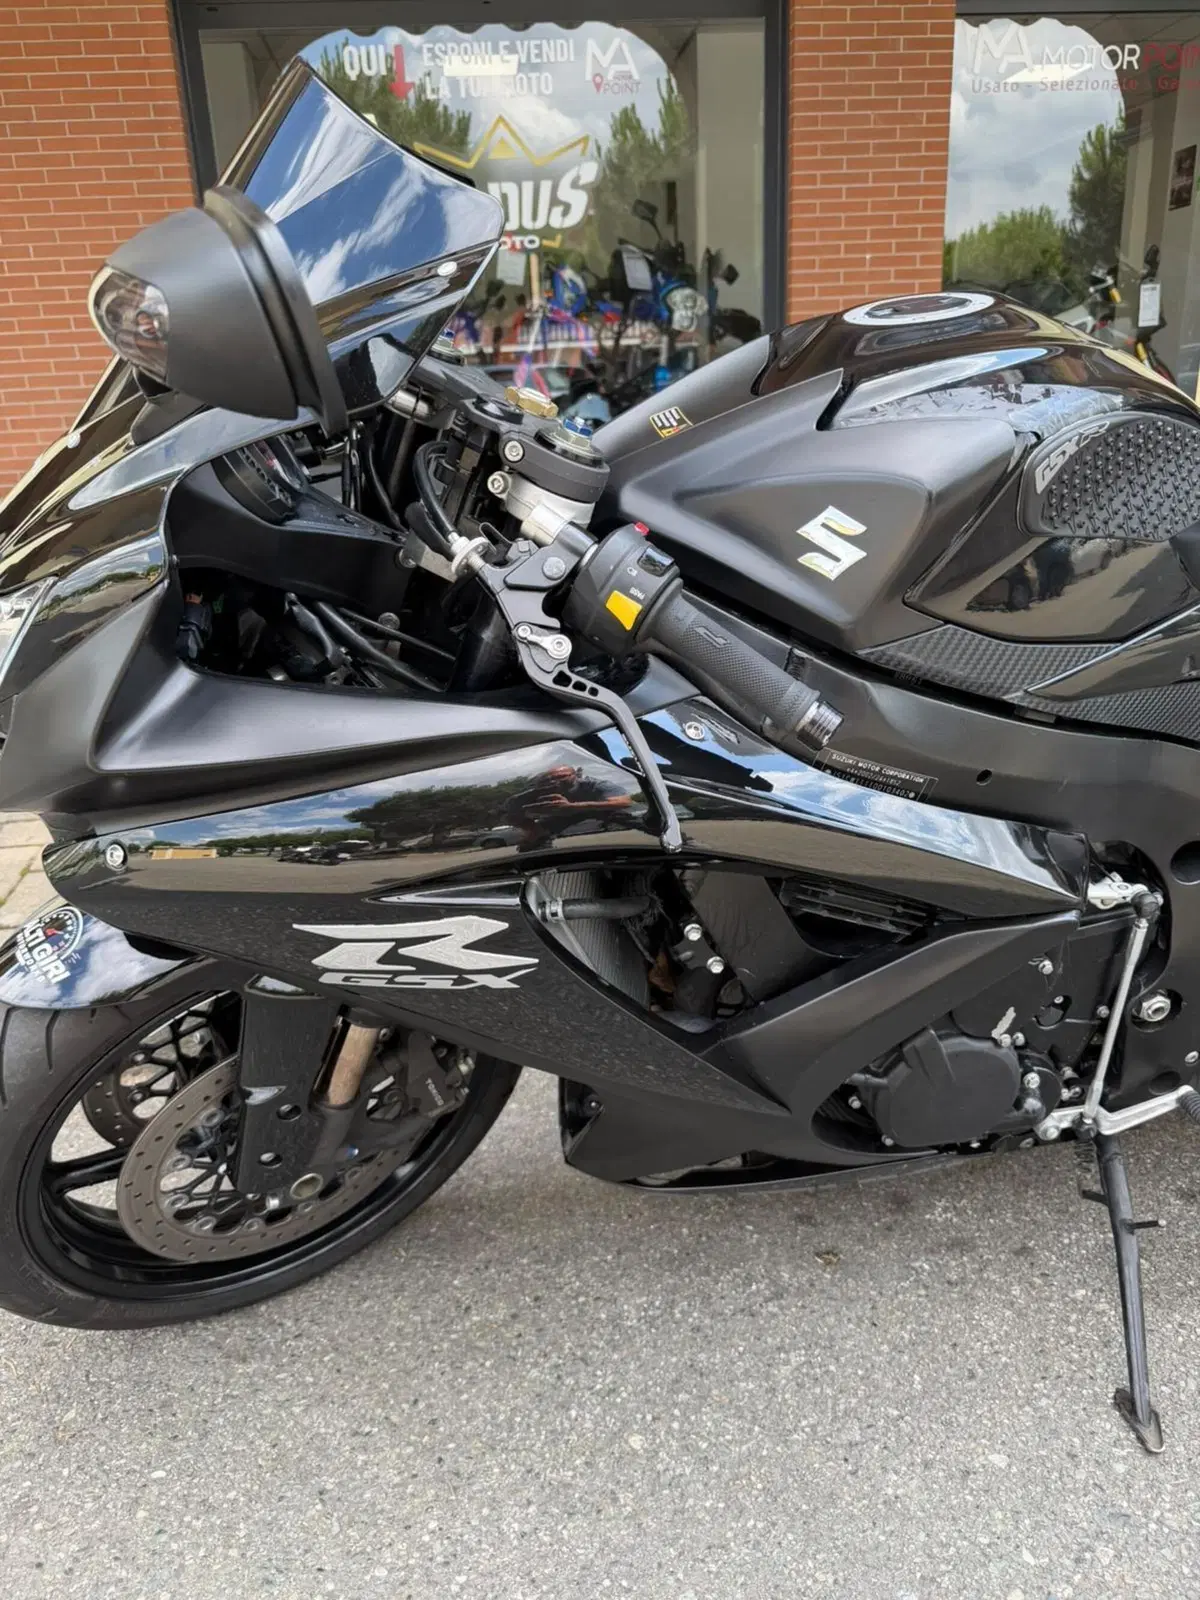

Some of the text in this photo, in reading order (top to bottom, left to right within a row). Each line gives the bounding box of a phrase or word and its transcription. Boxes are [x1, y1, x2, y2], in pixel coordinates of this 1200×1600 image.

[343, 38, 575, 81] QUI ESPONI E VENDI
[425, 75, 452, 100] LA
[603, 81, 641, 95] POINT
[972, 77, 1019, 93] Usato
[1040, 75, 1137, 92] Selezionato
[832, 753, 925, 783] SUZUKI MOTOR CORPORATION
[23, 919, 71, 984] ALTI GIRI
[318, 967, 538, 989] GSX
